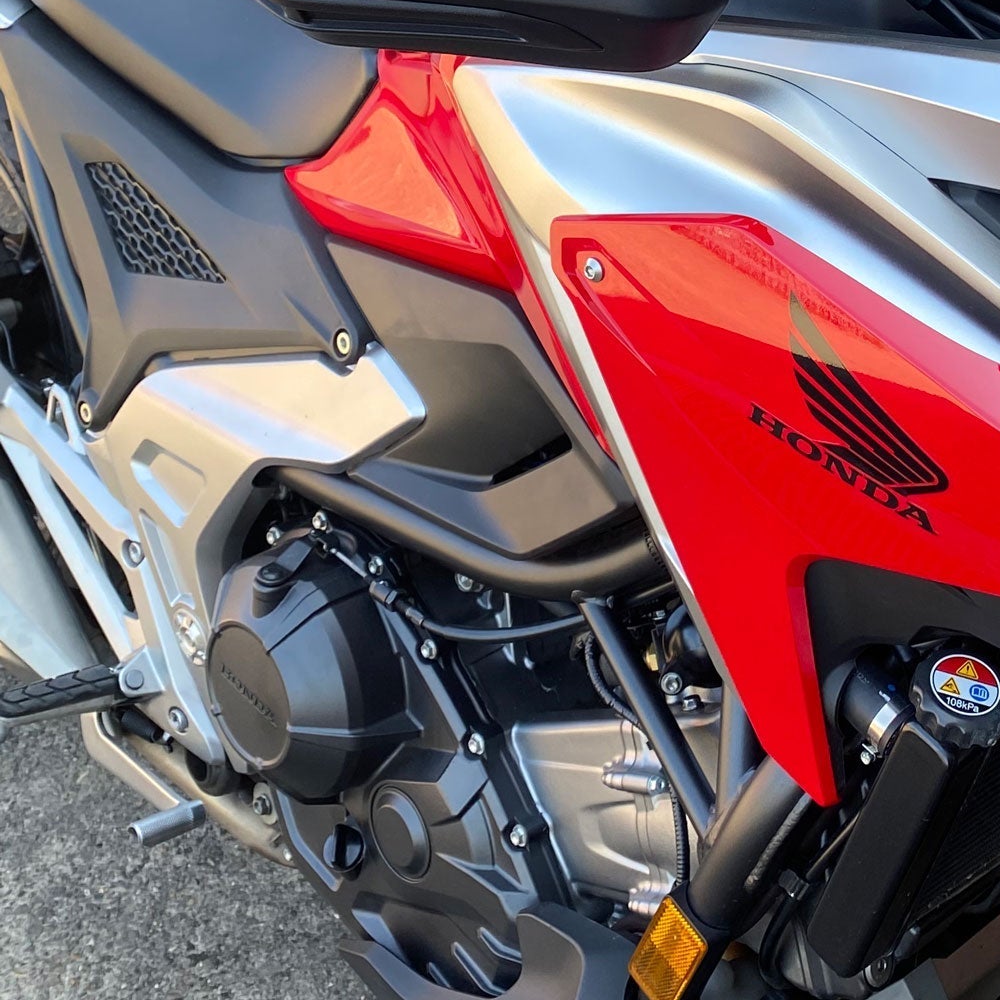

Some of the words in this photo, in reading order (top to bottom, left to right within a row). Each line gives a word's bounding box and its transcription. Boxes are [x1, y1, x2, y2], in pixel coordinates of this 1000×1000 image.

[748, 404, 938, 535] HONDA
[220, 663, 278, 727] HONDA
[946, 697, 979, 713] 108kPa
